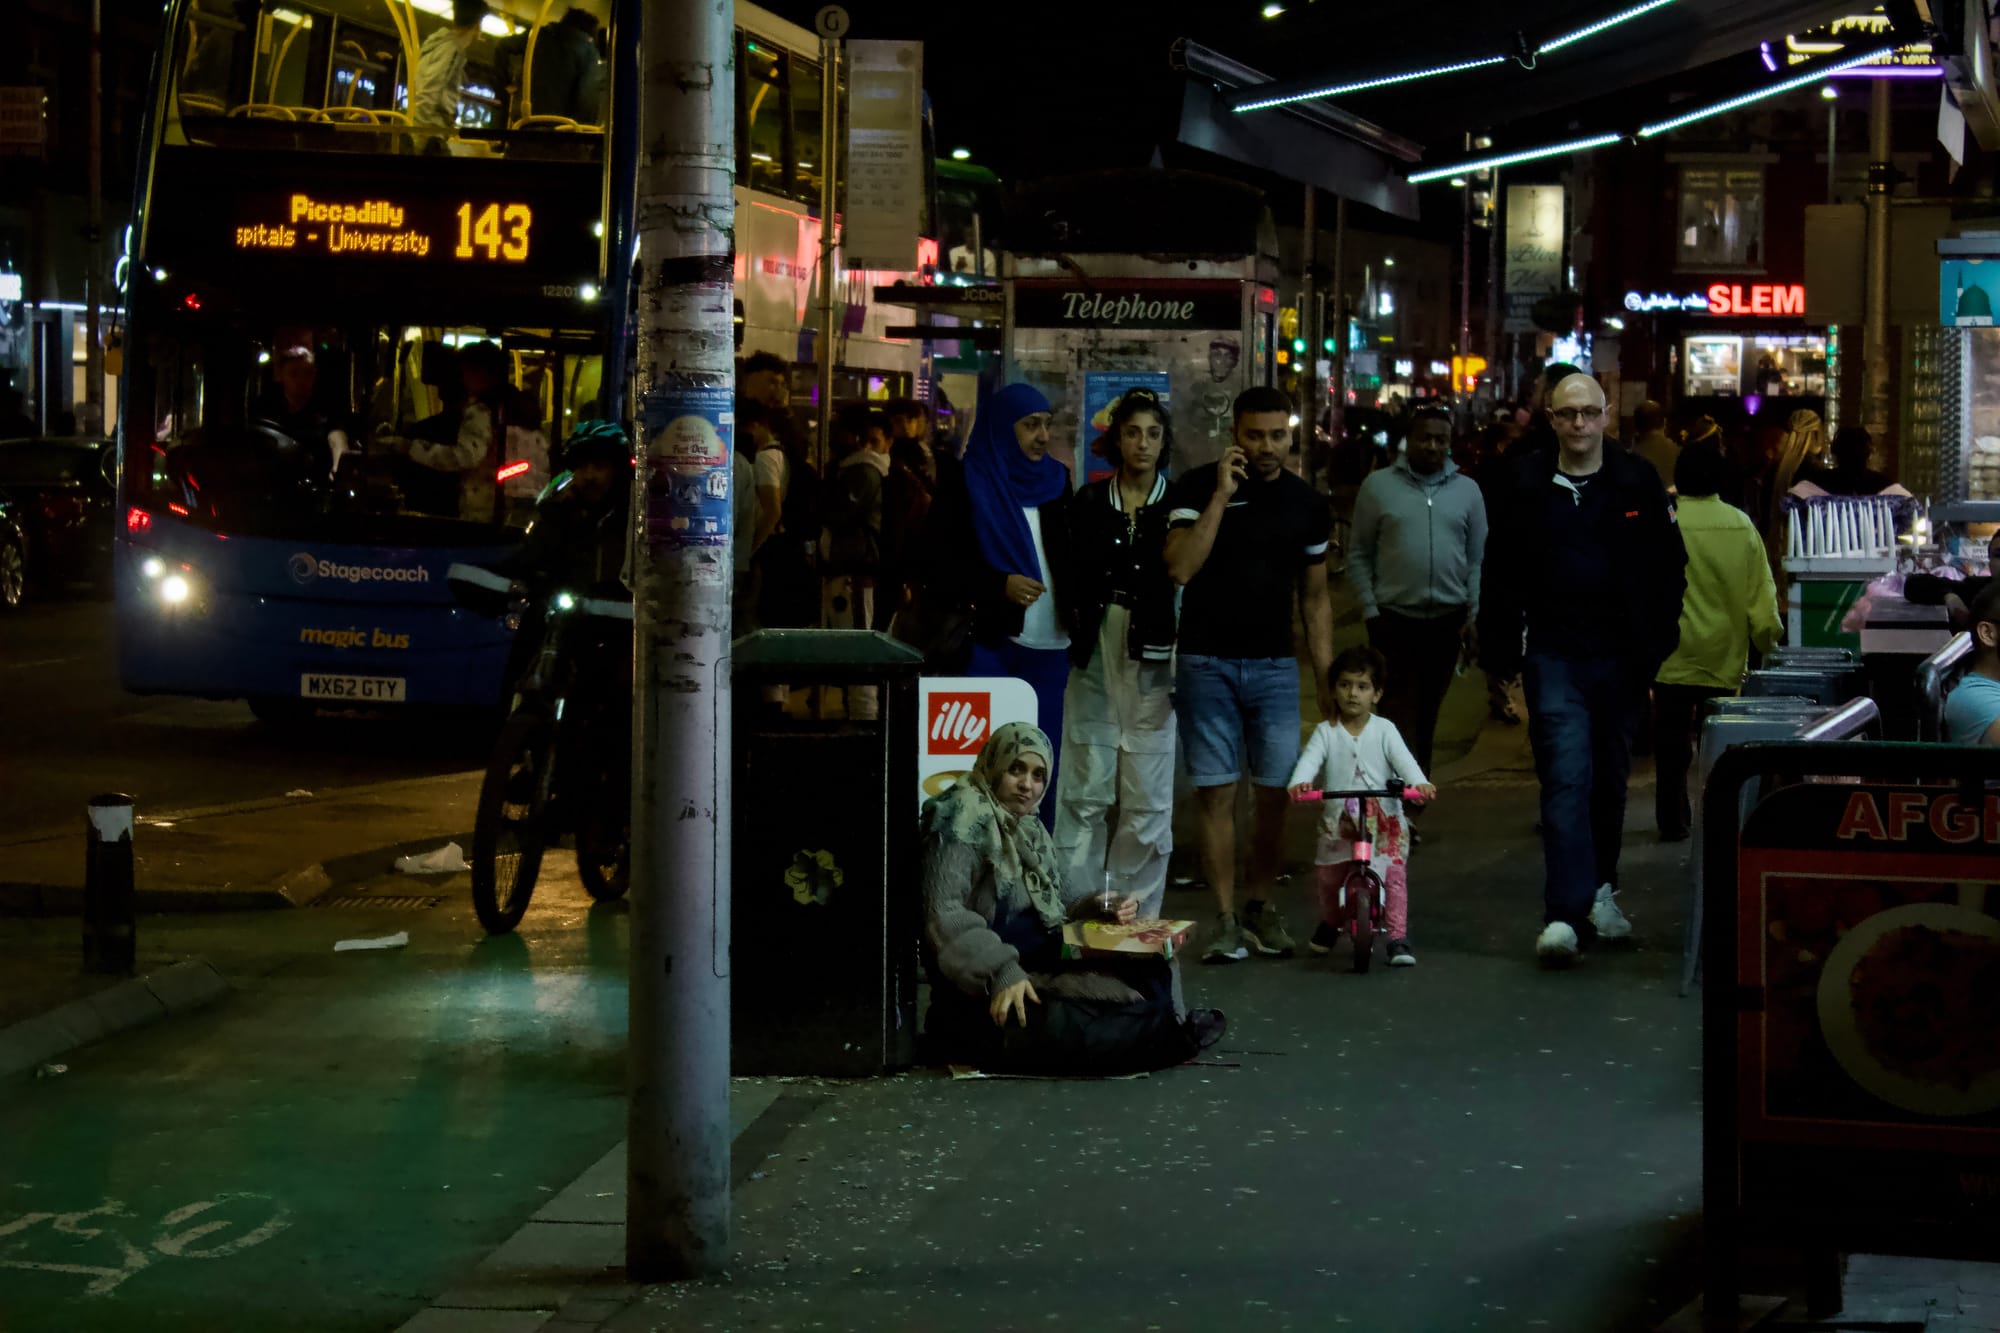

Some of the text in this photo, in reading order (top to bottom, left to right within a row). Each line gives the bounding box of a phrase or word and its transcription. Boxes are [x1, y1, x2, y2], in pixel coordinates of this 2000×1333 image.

[291, 194, 404, 227] Piccadilly
[329, 224, 429, 257] University
[455, 202, 531, 260] 143
[1062, 291, 1196, 325] Telephone
[318, 559, 430, 584] Stagecoach
[300, 626, 410, 649] magic bus
[308, 677, 397, 697] MX62 GTY
[931, 700, 987, 750] illy
